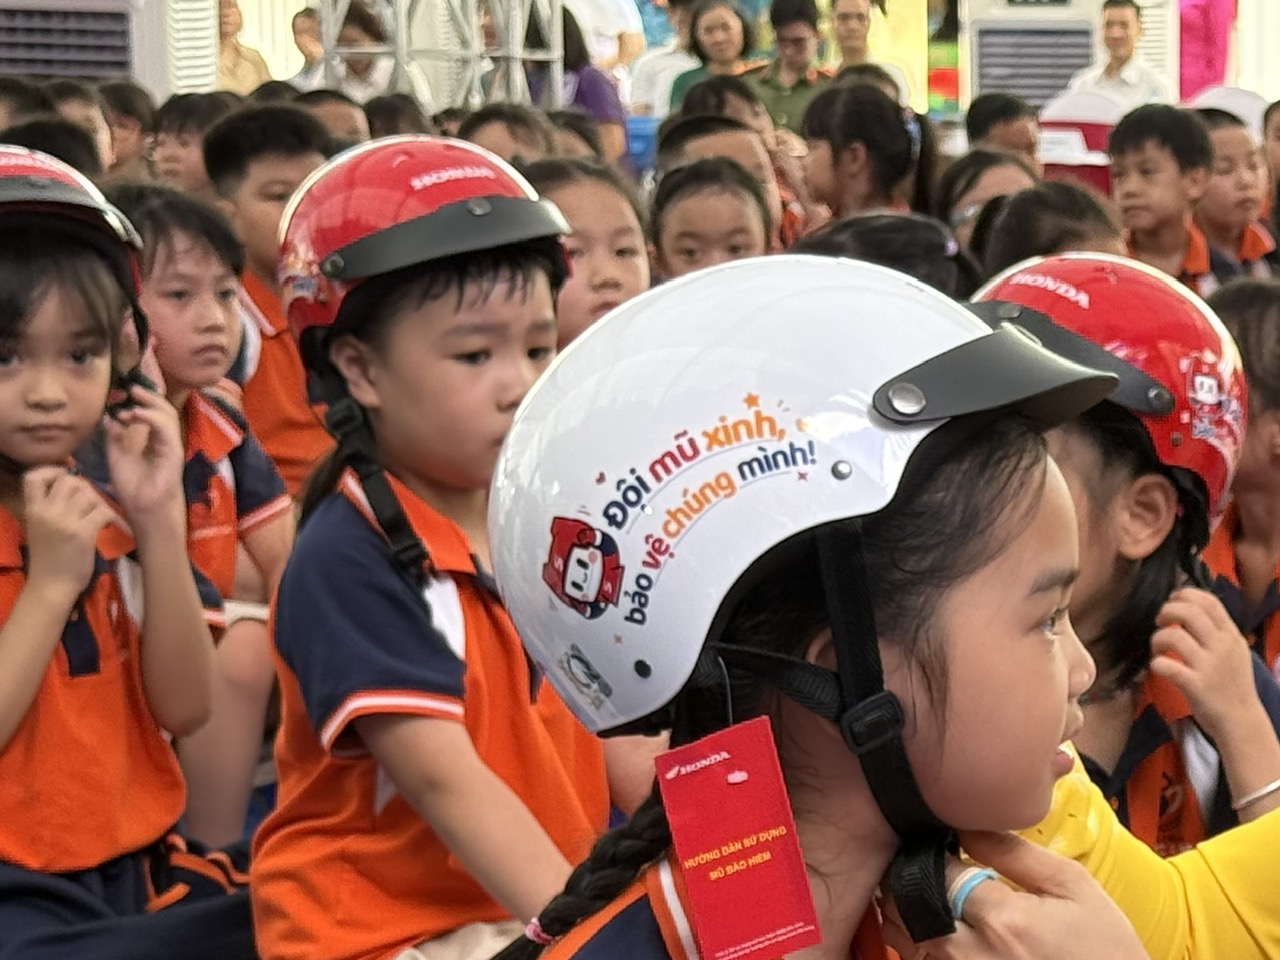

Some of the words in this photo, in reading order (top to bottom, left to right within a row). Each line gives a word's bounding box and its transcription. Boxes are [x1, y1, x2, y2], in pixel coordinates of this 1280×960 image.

[1009, 274, 1090, 310] HONDA
[602, 467, 652, 530] Đội
[648, 430, 701, 483] mũ
[702, 410, 786, 452] xinh,
[624, 573, 654, 626] bảo
[641, 533, 675, 570] vệ
[661, 471, 738, 538] chúng
[737, 440, 818, 481] mình!
[680, 751, 731, 775] HONDA
